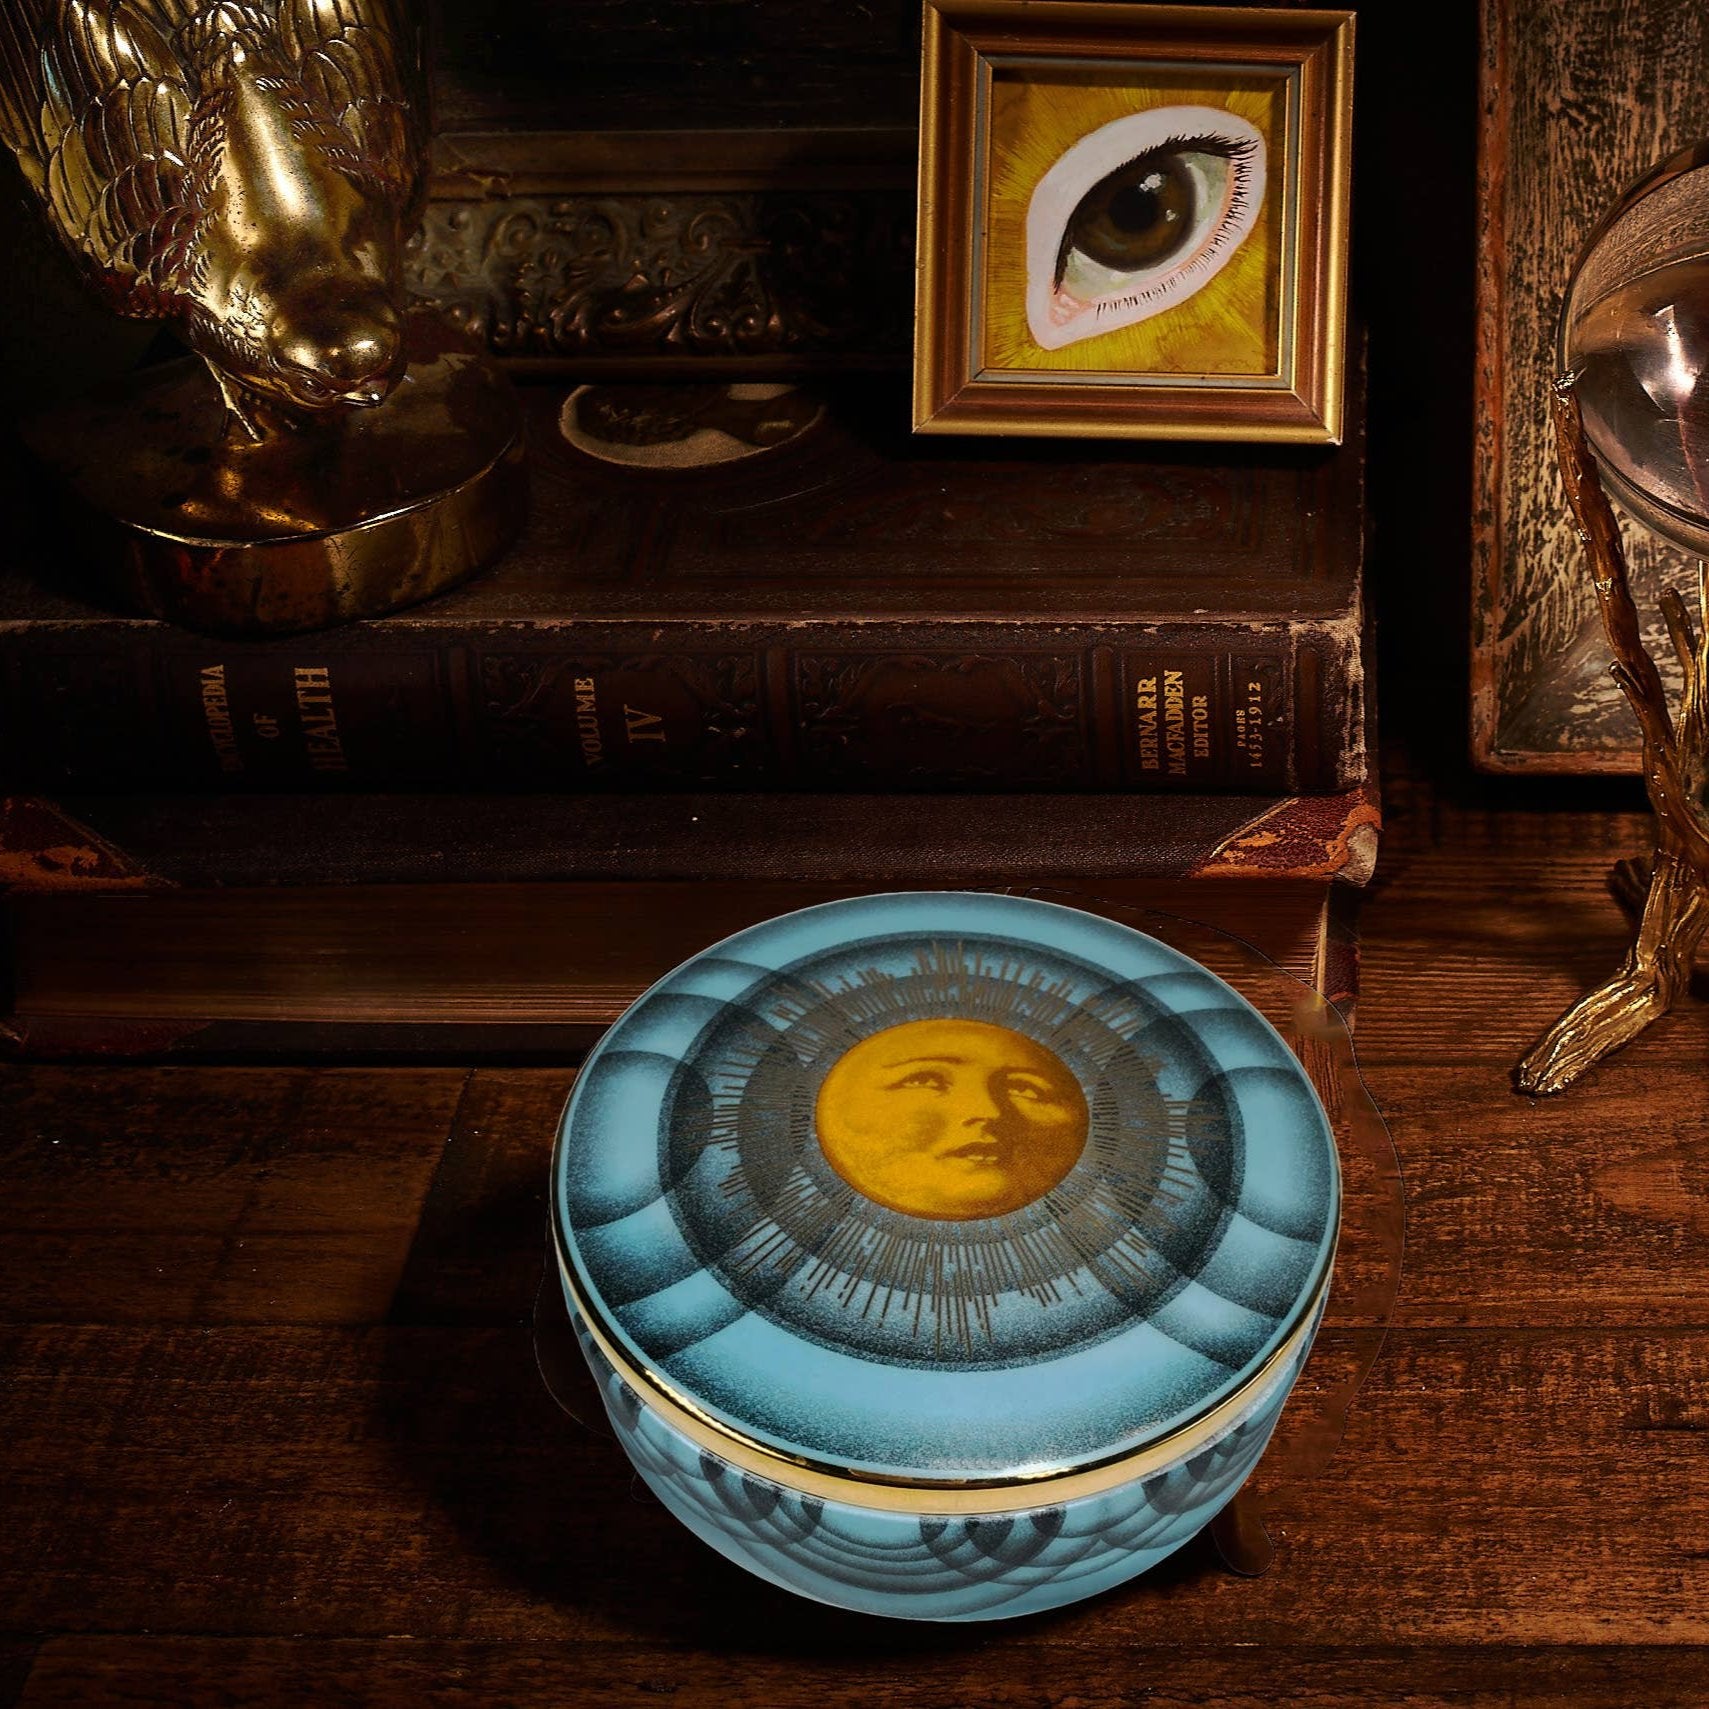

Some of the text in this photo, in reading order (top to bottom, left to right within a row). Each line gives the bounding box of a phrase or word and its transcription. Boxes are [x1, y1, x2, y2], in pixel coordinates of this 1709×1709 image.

[200, 664, 245, 773] YCLOPEDIA
[253, 712, 280, 740] OF
[294, 666, 349, 771] HEALTH
[574, 677, 604, 768] VOLUME
[624, 703, 666, 743] IV
[1137, 676, 1160, 770] BERNARR
[1164, 669, 1187, 776] MACFADDEN
[1191, 695, 1209, 758] EDITOR
[1235, 709, 1247, 748] PAGES
[1248, 681, 1263, 768] 1453-1912
